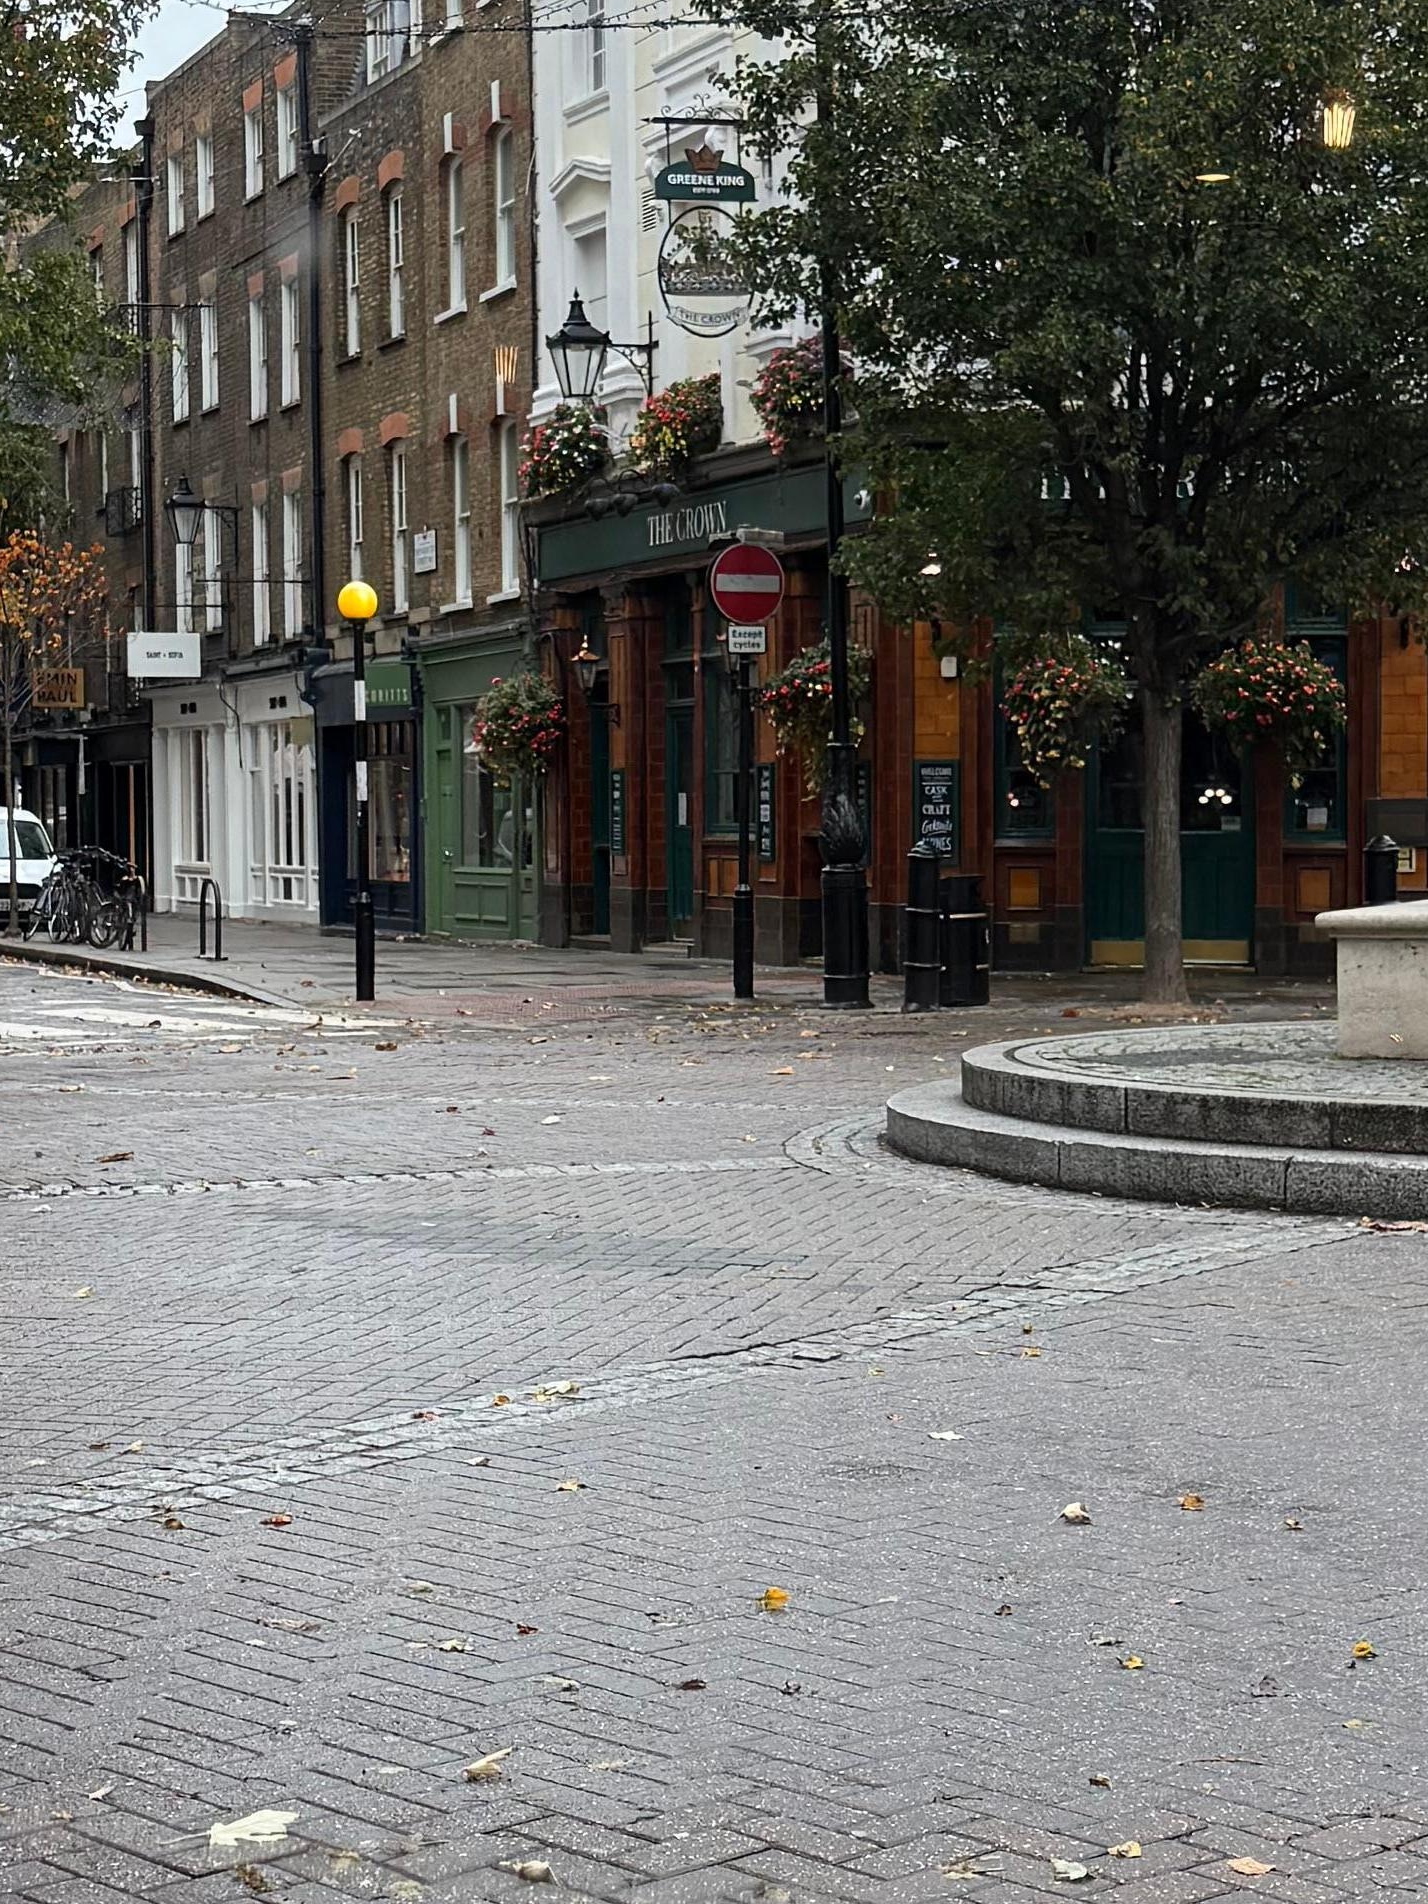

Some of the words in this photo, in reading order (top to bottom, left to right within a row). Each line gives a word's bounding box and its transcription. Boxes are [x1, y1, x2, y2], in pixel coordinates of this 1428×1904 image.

[667, 173, 715, 187] GREENE
[716, 175, 745, 187] KING
[700, 310, 741, 324] CROWN
[647, 512, 674, 546] THE
[676, 500, 727, 541] CROWN
[731, 629, 763, 640] Except
[733, 640, 761, 650] cycles
[924, 786, 948, 795] CASK
[922, 804, 951, 815] CRAFT
